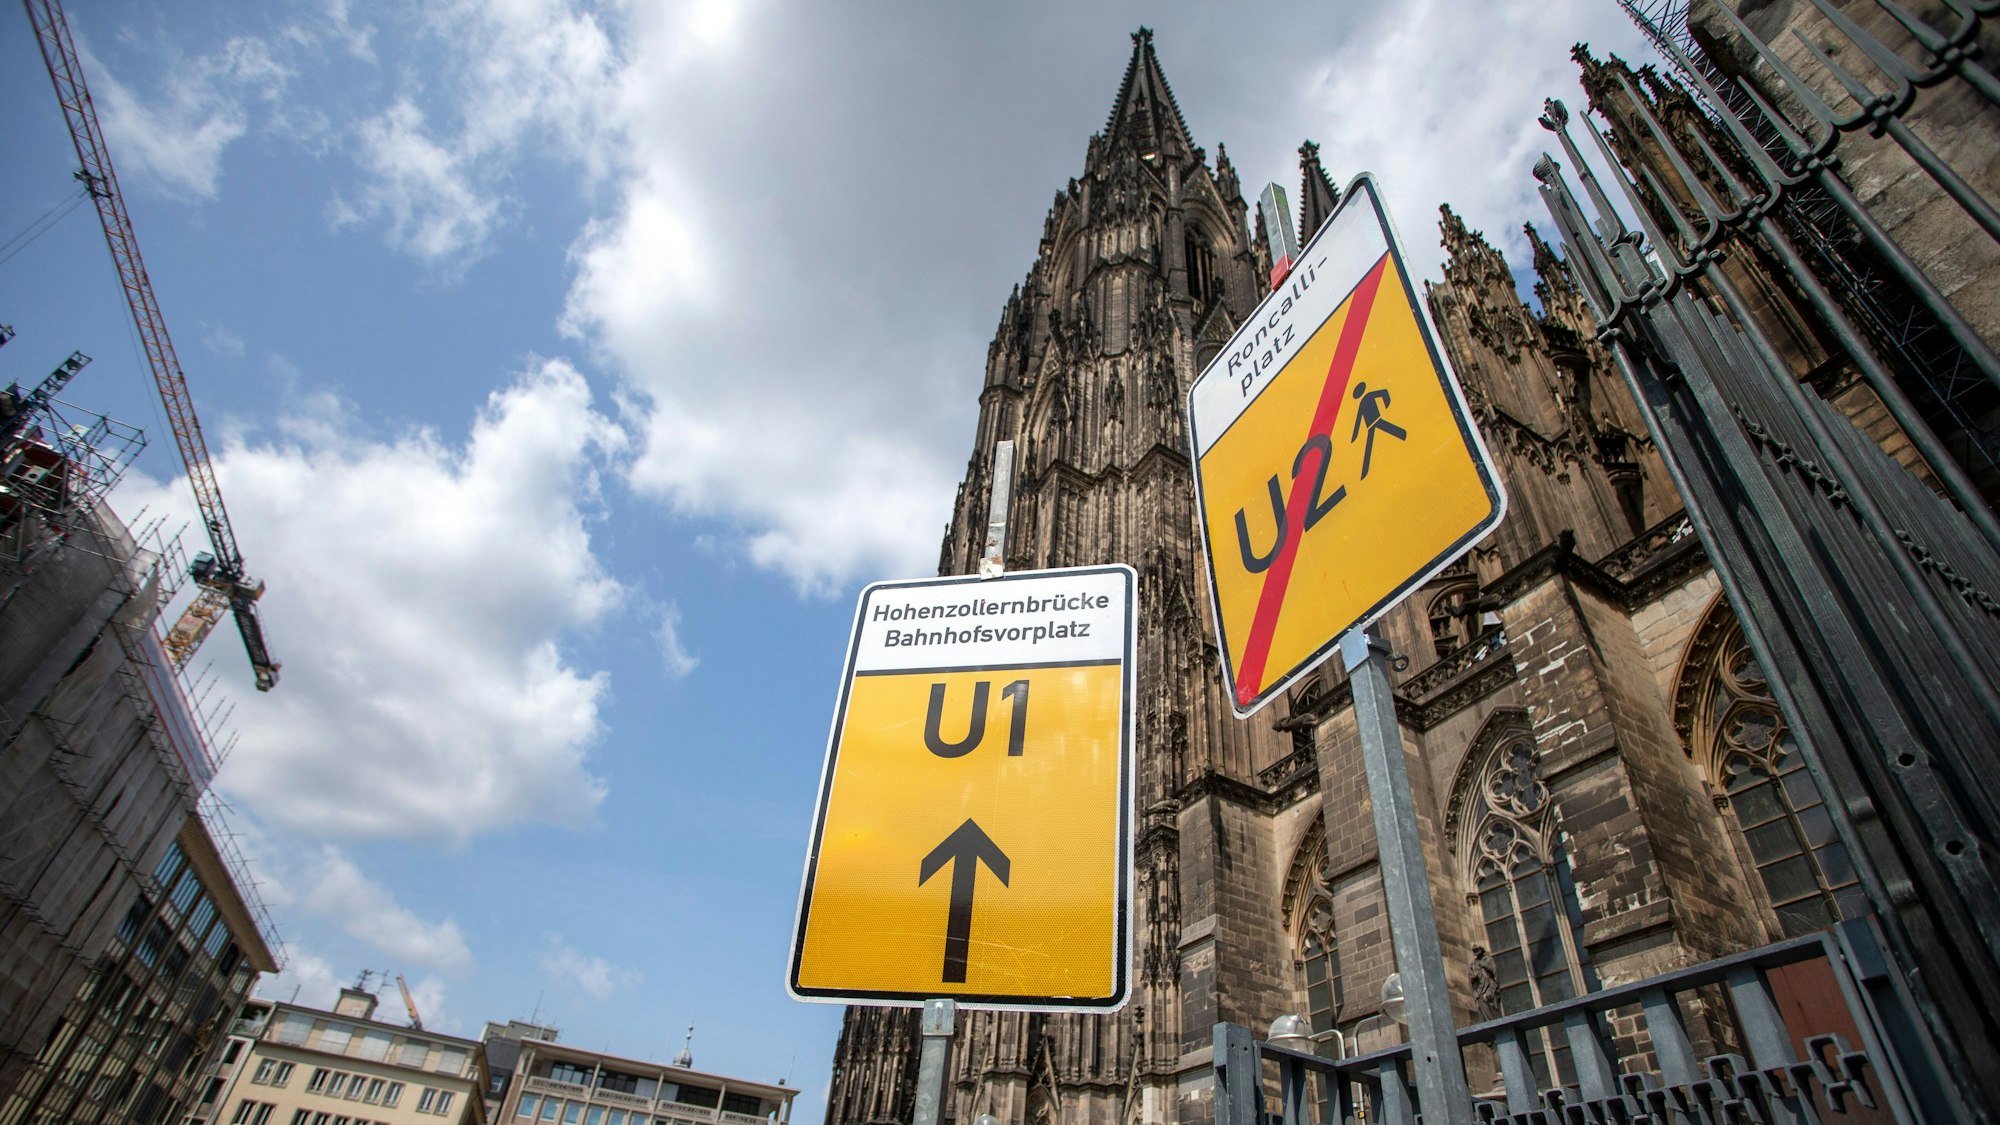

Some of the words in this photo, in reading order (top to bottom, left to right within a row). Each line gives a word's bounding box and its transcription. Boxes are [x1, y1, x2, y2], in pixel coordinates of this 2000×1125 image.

[1227, 256, 1328, 378] Roncalli-
[1240, 323, 1296, 398] platz
[1233, 432, 1348, 574] U2
[872, 592, 1110, 622] Hohenzollernbrücke
[883, 620, 1091, 648] Bahnhofsvorplatz
[923, 679, 1030, 759] U1
